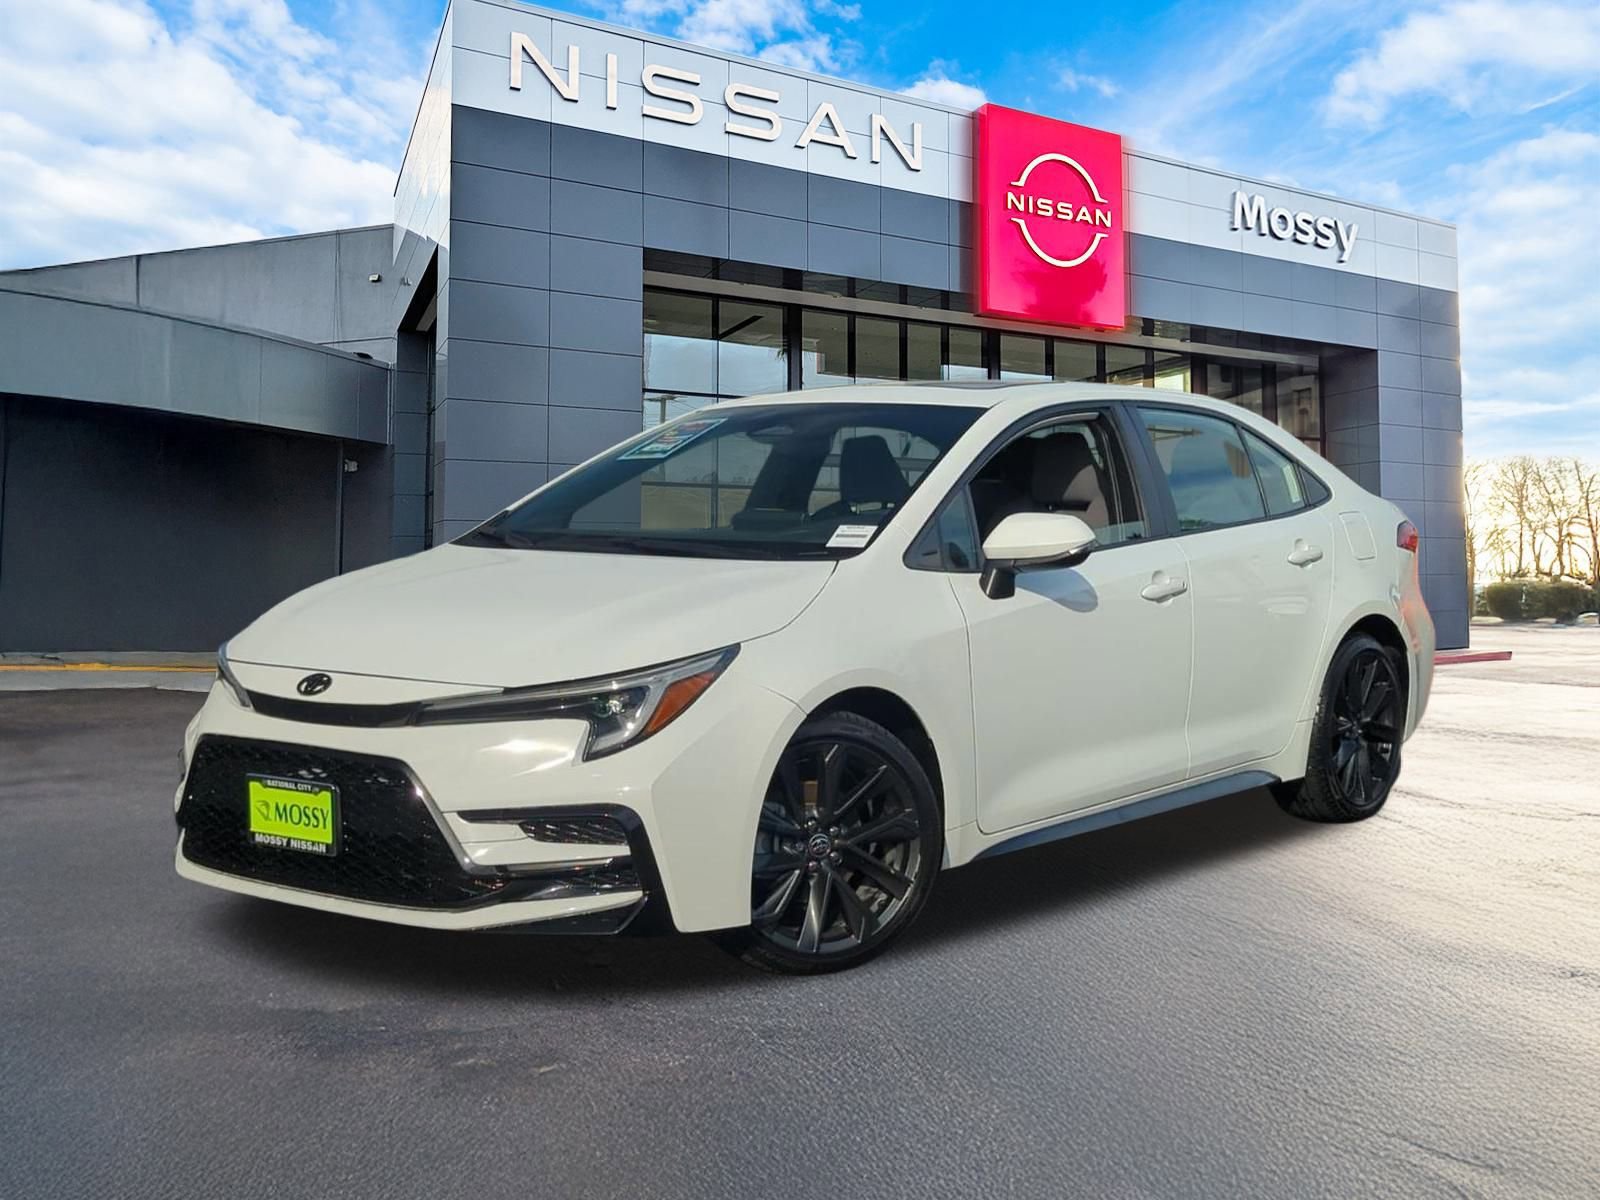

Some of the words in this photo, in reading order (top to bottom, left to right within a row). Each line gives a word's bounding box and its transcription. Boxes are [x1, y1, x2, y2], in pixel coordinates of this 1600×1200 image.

[509, 32, 923, 172] NISSAN
[1007, 191, 1112, 228] NISSAN
[1230, 190, 1361, 263] Mossy
[297, 783, 312, 792] CITY
[274, 802, 329, 830] MOSSY
[255, 833, 288, 847] MOSSY
[290, 838, 327, 853] NISSAN
